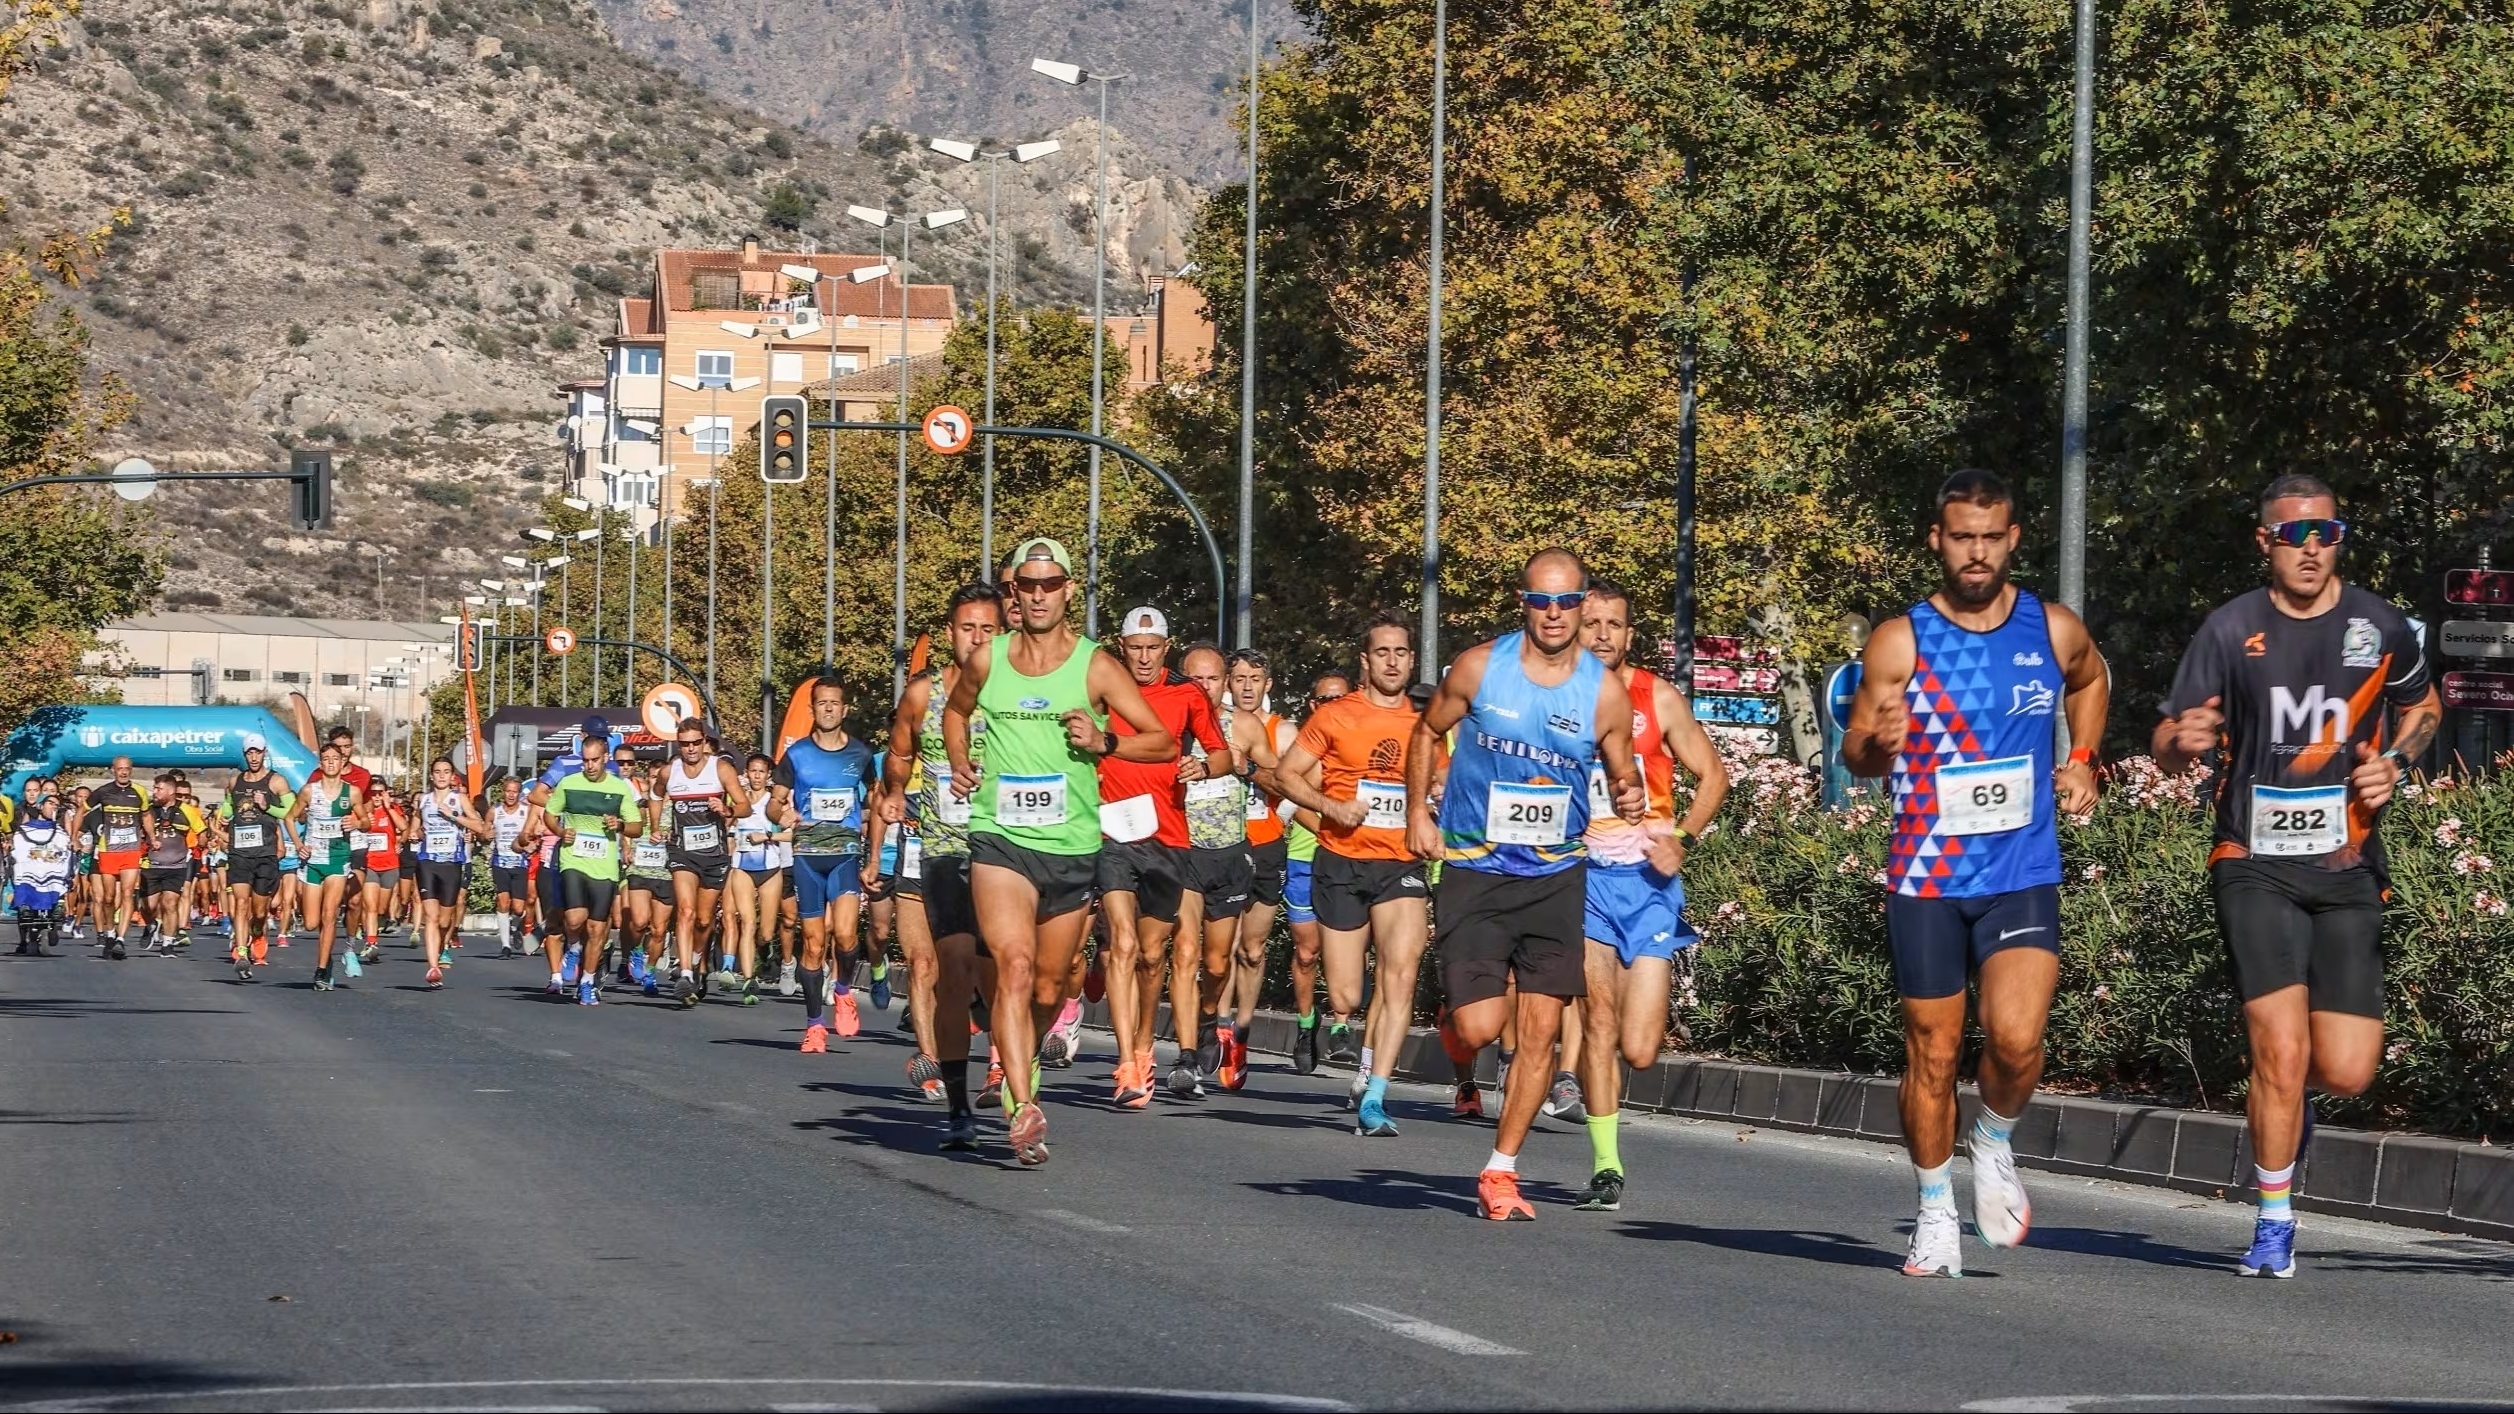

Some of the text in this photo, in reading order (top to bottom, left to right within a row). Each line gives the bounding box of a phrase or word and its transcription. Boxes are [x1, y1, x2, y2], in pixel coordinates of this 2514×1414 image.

[2444, 632, 2498, 644] Servicios
[2448, 688, 2487, 700] Severo
[2269, 684, 2350, 744] Mh
[110, 727, 225, 749] caixapetrer
[184, 745, 225, 753] Obra Social
[1012, 790, 1052, 808] 199
[1972, 782, 2008, 807] 69
[821, 798, 846, 809] 348
[1371, 796, 1404, 812] 210
[1508, 803, 1553, 823] 209
[2270, 808, 2327, 831] 282
[319, 823, 337, 831] 261
[239, 832, 256, 840] 106
[432, 837, 450, 845] 227
[692, 832, 712, 842] 103
[582, 840, 601, 850] 161
[642, 850, 661, 859] 345
